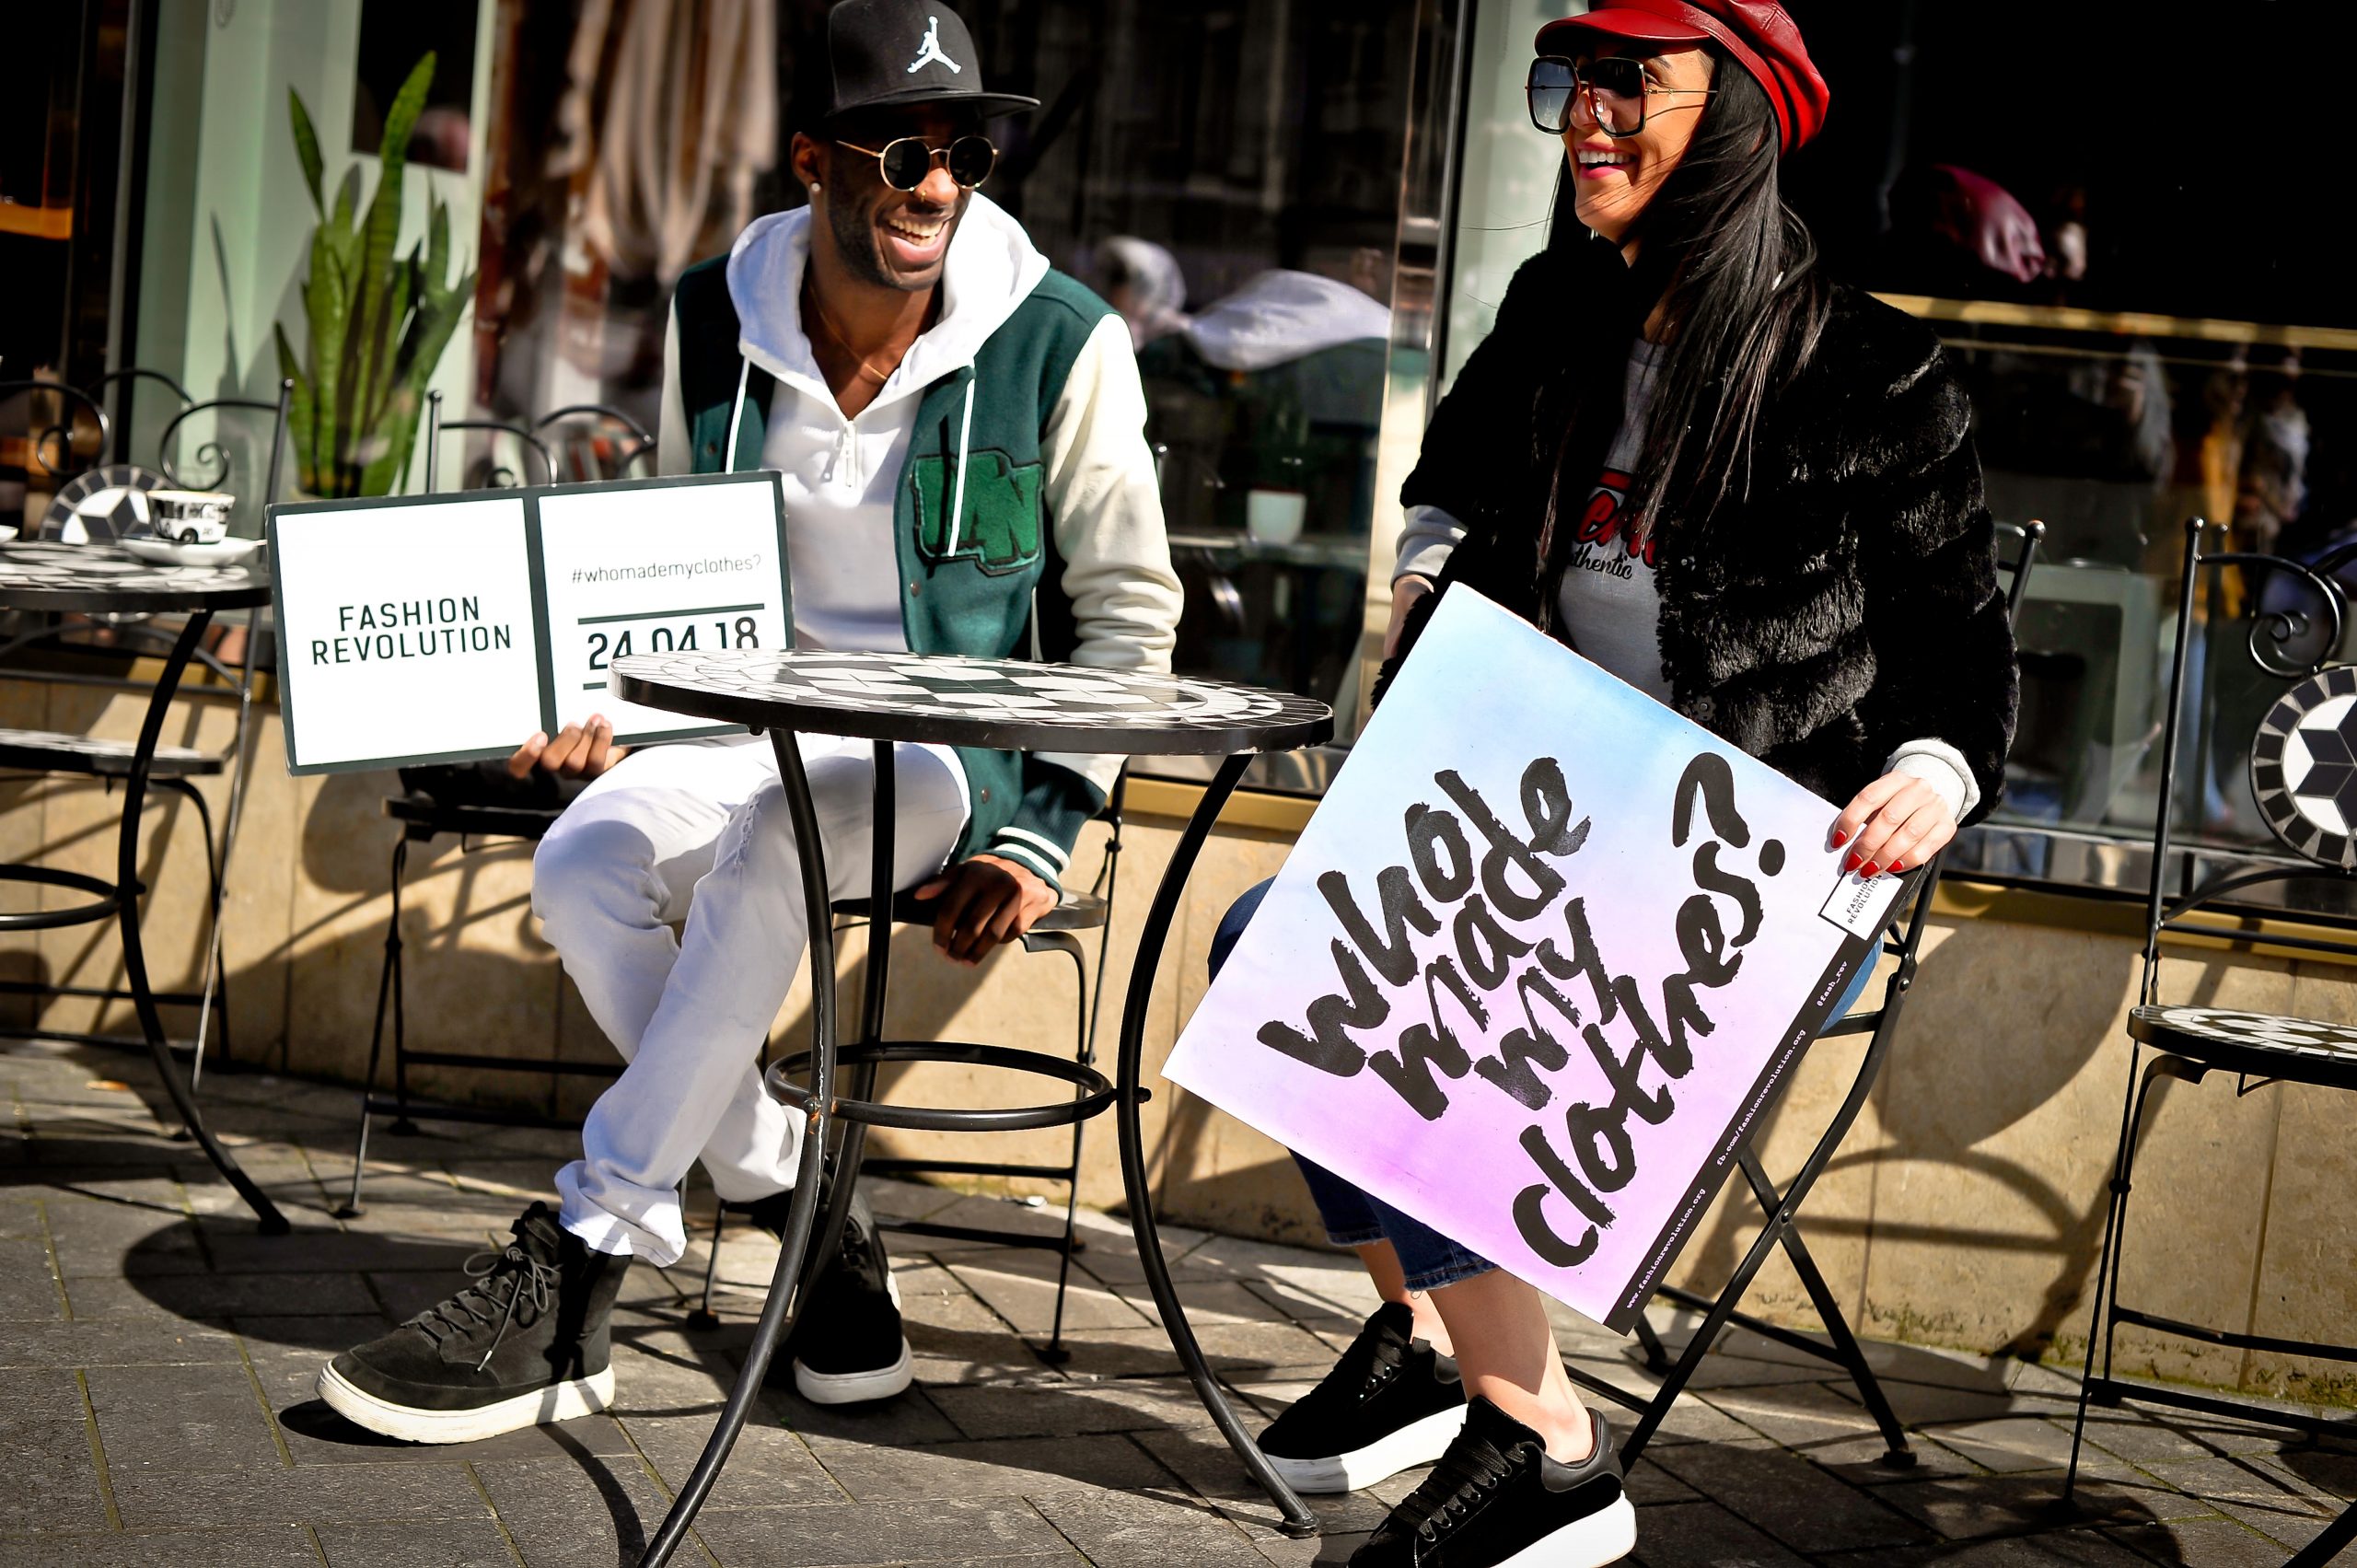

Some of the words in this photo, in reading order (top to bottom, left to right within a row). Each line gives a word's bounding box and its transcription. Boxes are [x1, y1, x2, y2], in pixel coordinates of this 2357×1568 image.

[571, 553, 762, 585] #whomademyclothes?
[1573, 543, 1633, 580] thentic
[339, 595, 481, 633] FASHION
[312, 623, 512, 666] REVOLUTION
[1846, 876, 1873, 914] FASHION
[1847, 874, 1883, 924] REVOLUTION
[1257, 801, 1476, 1078] who
[1368, 757, 1592, 1121] made
[1474, 897, 1620, 1111] my
[1816, 960, 1849, 1007] @fash_rev
[1512, 751, 1786, 1268] clothes?
[1716, 1028, 1807, 1167] fb.com/fashionrevolution.org
[1626, 1188, 1707, 1309] www.fashionrevolution.org
